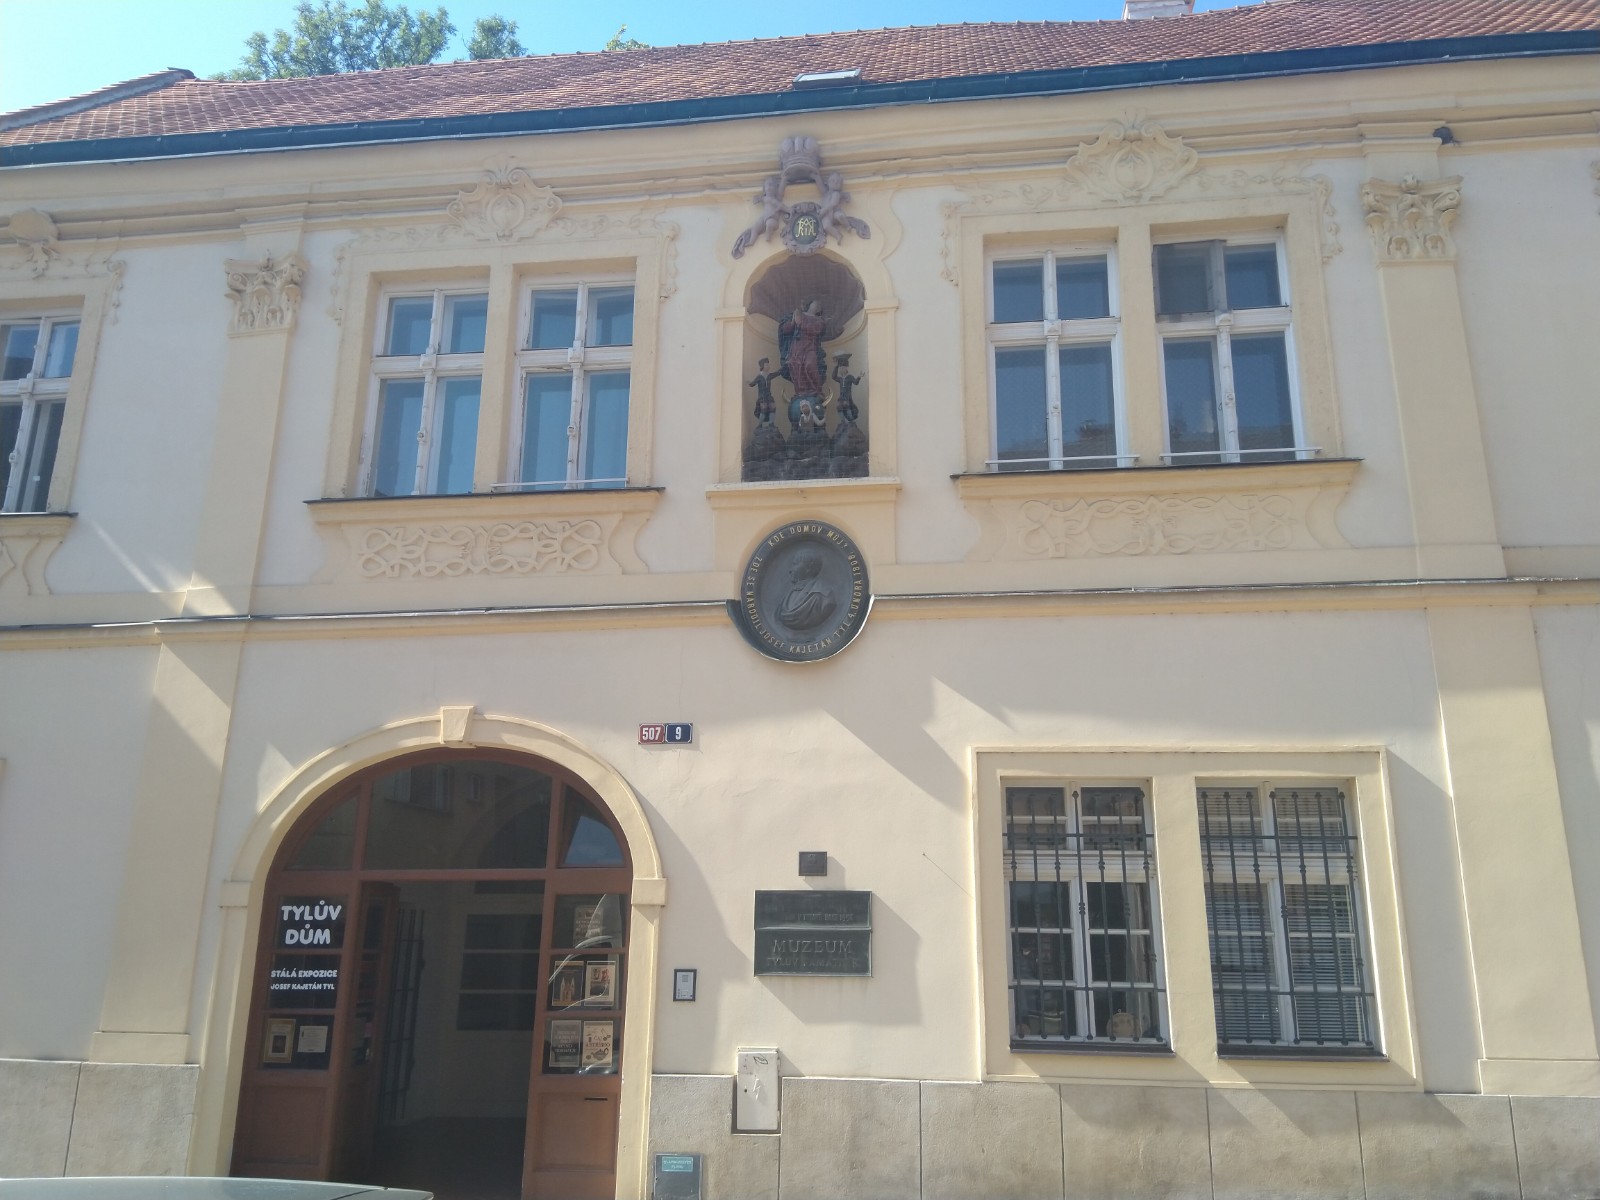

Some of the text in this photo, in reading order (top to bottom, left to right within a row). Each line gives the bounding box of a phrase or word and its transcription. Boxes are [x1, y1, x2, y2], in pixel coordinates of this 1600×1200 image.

[767, 531, 785, 547] KDE
[789, 525, 823, 535] DOMOV
[751, 556, 763, 573] ZDE
[746, 575, 755, 586] SE
[746, 591, 761, 629] NARODIL
[759, 629, 785, 648] JOSEF
[833, 621, 851, 639] TYL
[642, 726, 662, 741] 507
[675, 726, 682, 740] 9
[281, 900, 342, 921] TYLŮV
[285, 923, 331, 944] DŮM
[773, 939, 852, 954] MUZEUM
[270, 967, 338, 978] STÁLÁ EXPOZICE
[291, 981, 322, 990] KAJETÁN
